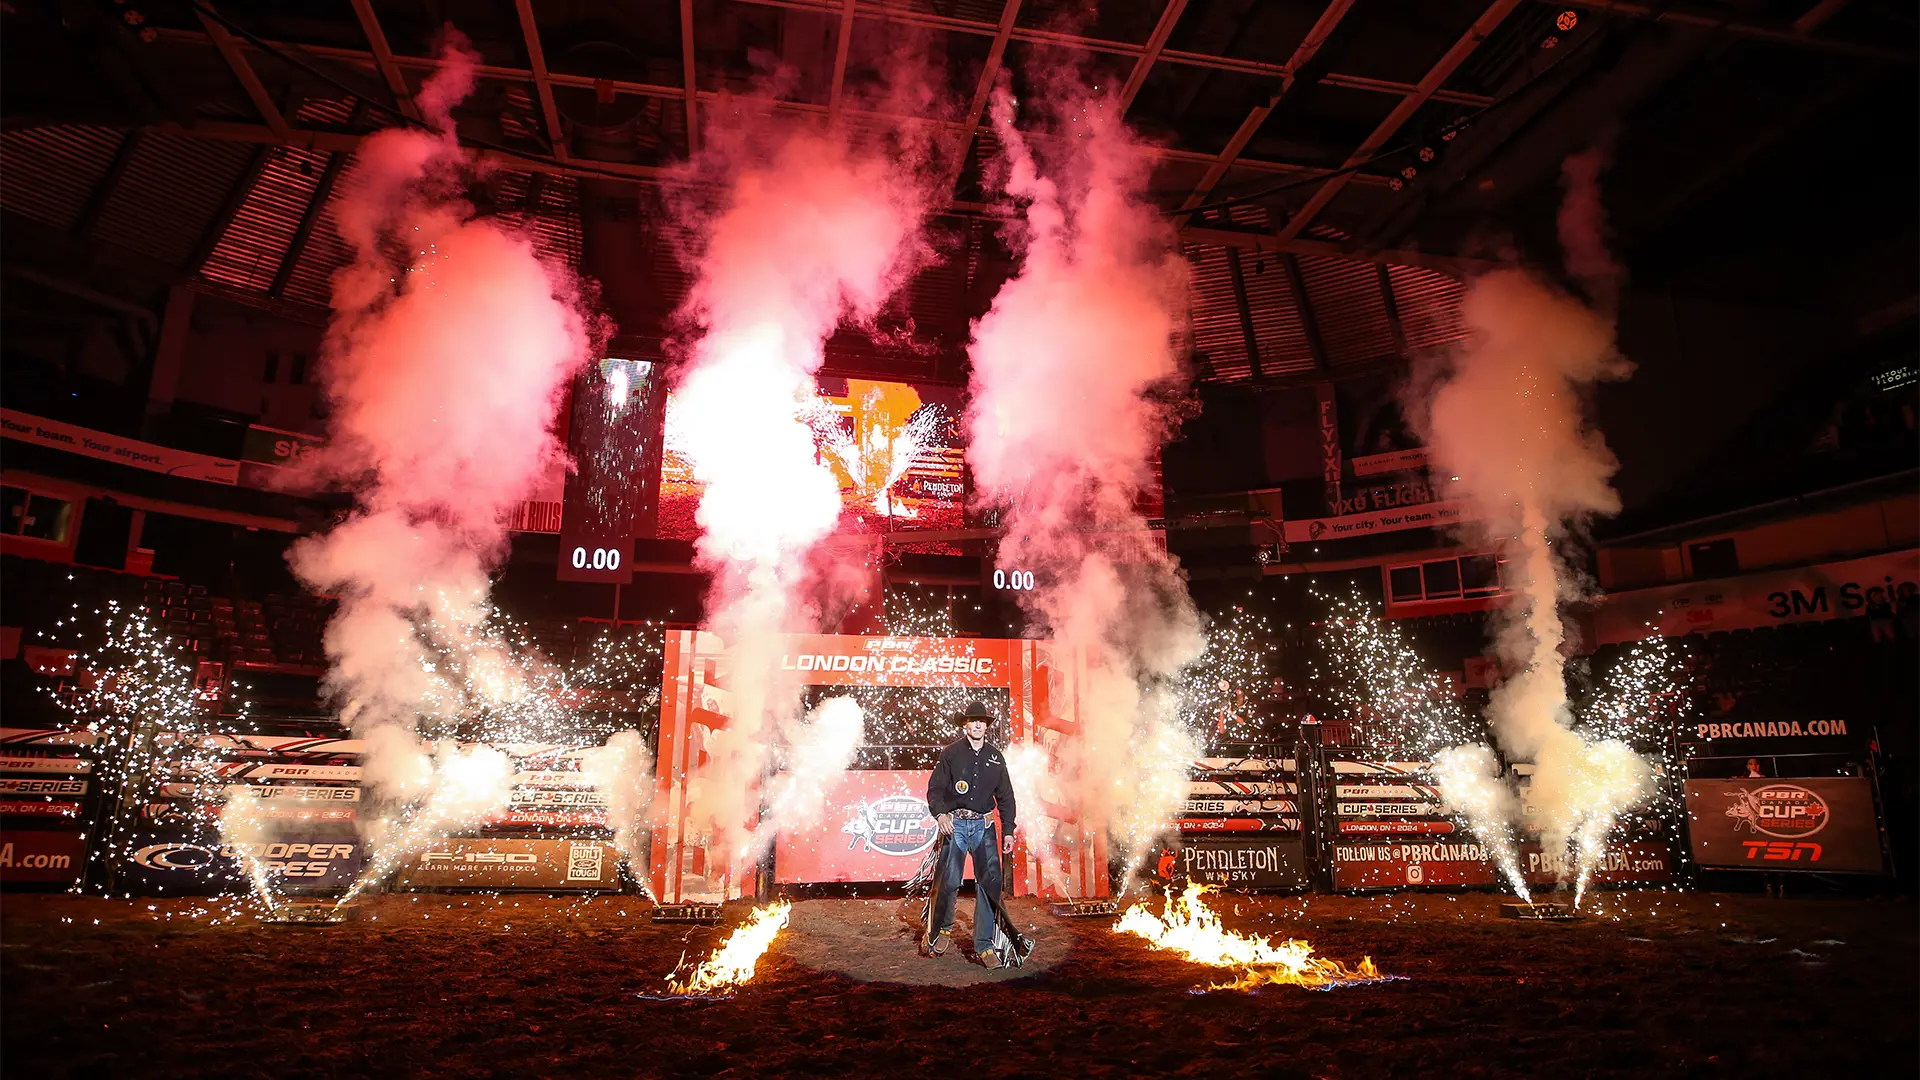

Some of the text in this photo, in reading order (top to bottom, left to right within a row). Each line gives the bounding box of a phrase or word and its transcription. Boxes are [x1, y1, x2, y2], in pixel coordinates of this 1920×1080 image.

[0, 418, 164, 466] Your team. Your airport.
[528, 500, 562, 532] BULLS
[1332, 522, 1352, 533] Your
[1355, 519, 1377, 531] city.
[1380, 516, 1402, 526] Your
[1404, 511, 1435, 523] team.
[572, 546, 621, 571] 0.00
[993, 569, 1035, 591] 0.00
[1767, 587, 1828, 618] 3M
[780, 654, 993, 674] LONDON CLASSIC
[1697, 720, 1847, 739] PBRCANADA.COM
[271, 767, 310, 776] PBR
[16, 781, 83, 792] SERIES
[295, 788, 355, 799] SERIES
[1760, 791, 1806, 799] PBR
[20, 804, 38, 813] ON
[1343, 804, 1418, 814] CUP SERIES
[1759, 805, 1806, 819] CUP
[875, 819, 920, 835] CUP
[1346, 824, 1379, 832] LONDON,
[1760, 819, 1815, 828] SERIES
[875, 834, 926, 844] SERIES
[420, 852, 538, 863] F-150
[573, 849, 599, 859] BUILT
[1336, 846, 1375, 862] FOLLOW
[1377, 846, 1391, 861] US
[1742, 840, 1822, 861] TSN
[1184, 846, 1279, 872] PENDLETON
[571, 869, 598, 877] TOUGH
